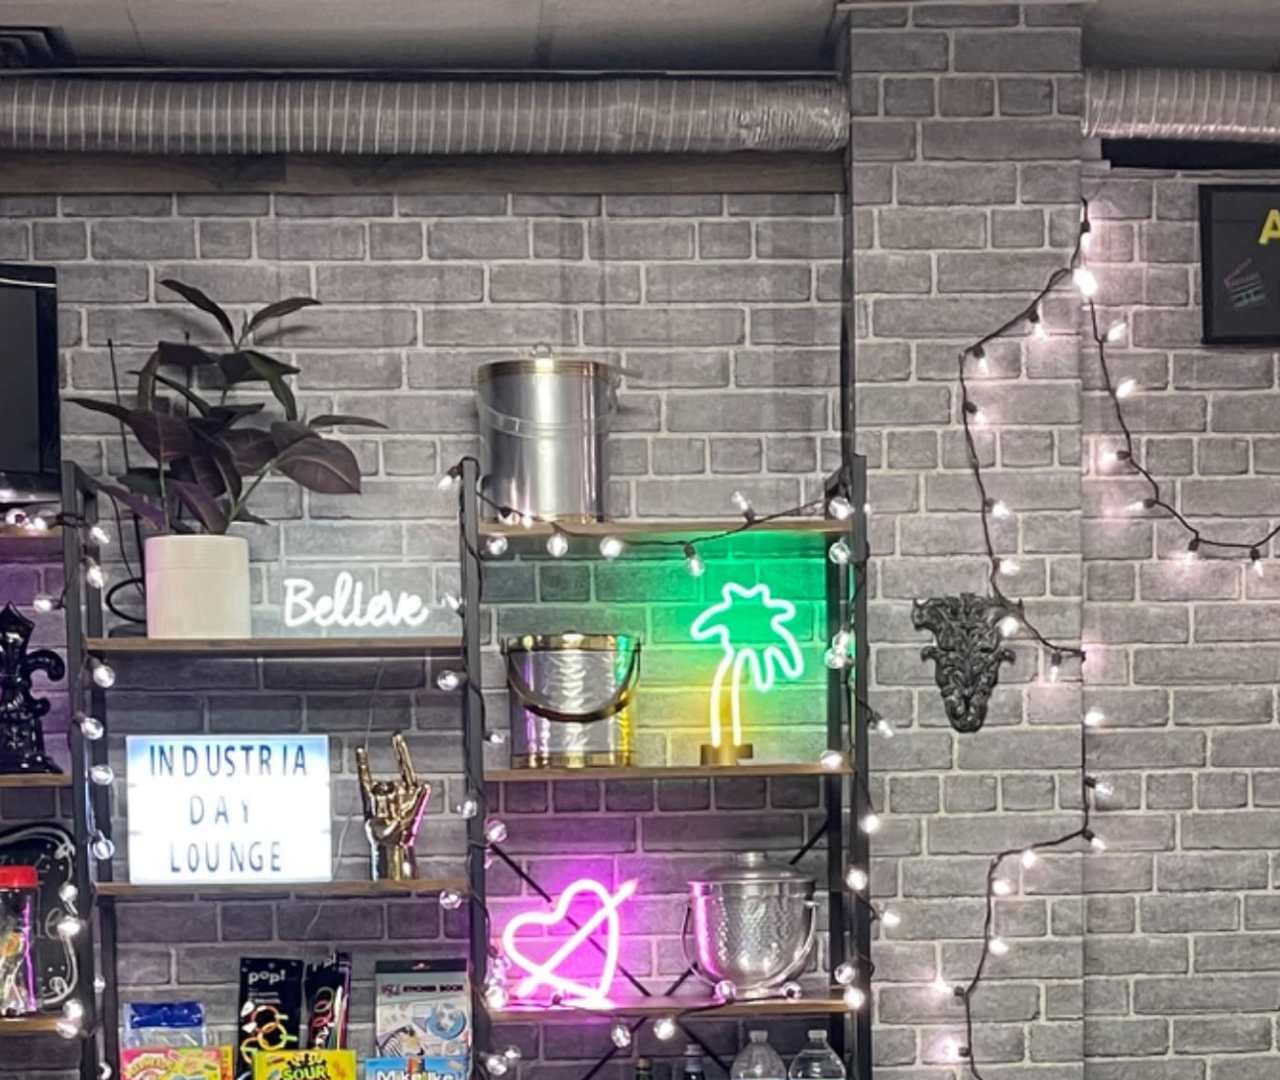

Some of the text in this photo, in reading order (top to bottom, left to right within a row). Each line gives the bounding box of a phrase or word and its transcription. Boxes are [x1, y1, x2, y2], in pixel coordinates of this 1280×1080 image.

[283, 571, 430, 628] Believe
[150, 744, 307, 776] INDUSTRIA
[189, 796, 252, 825] DAY
[170, 840, 282, 872] LOUNGE
